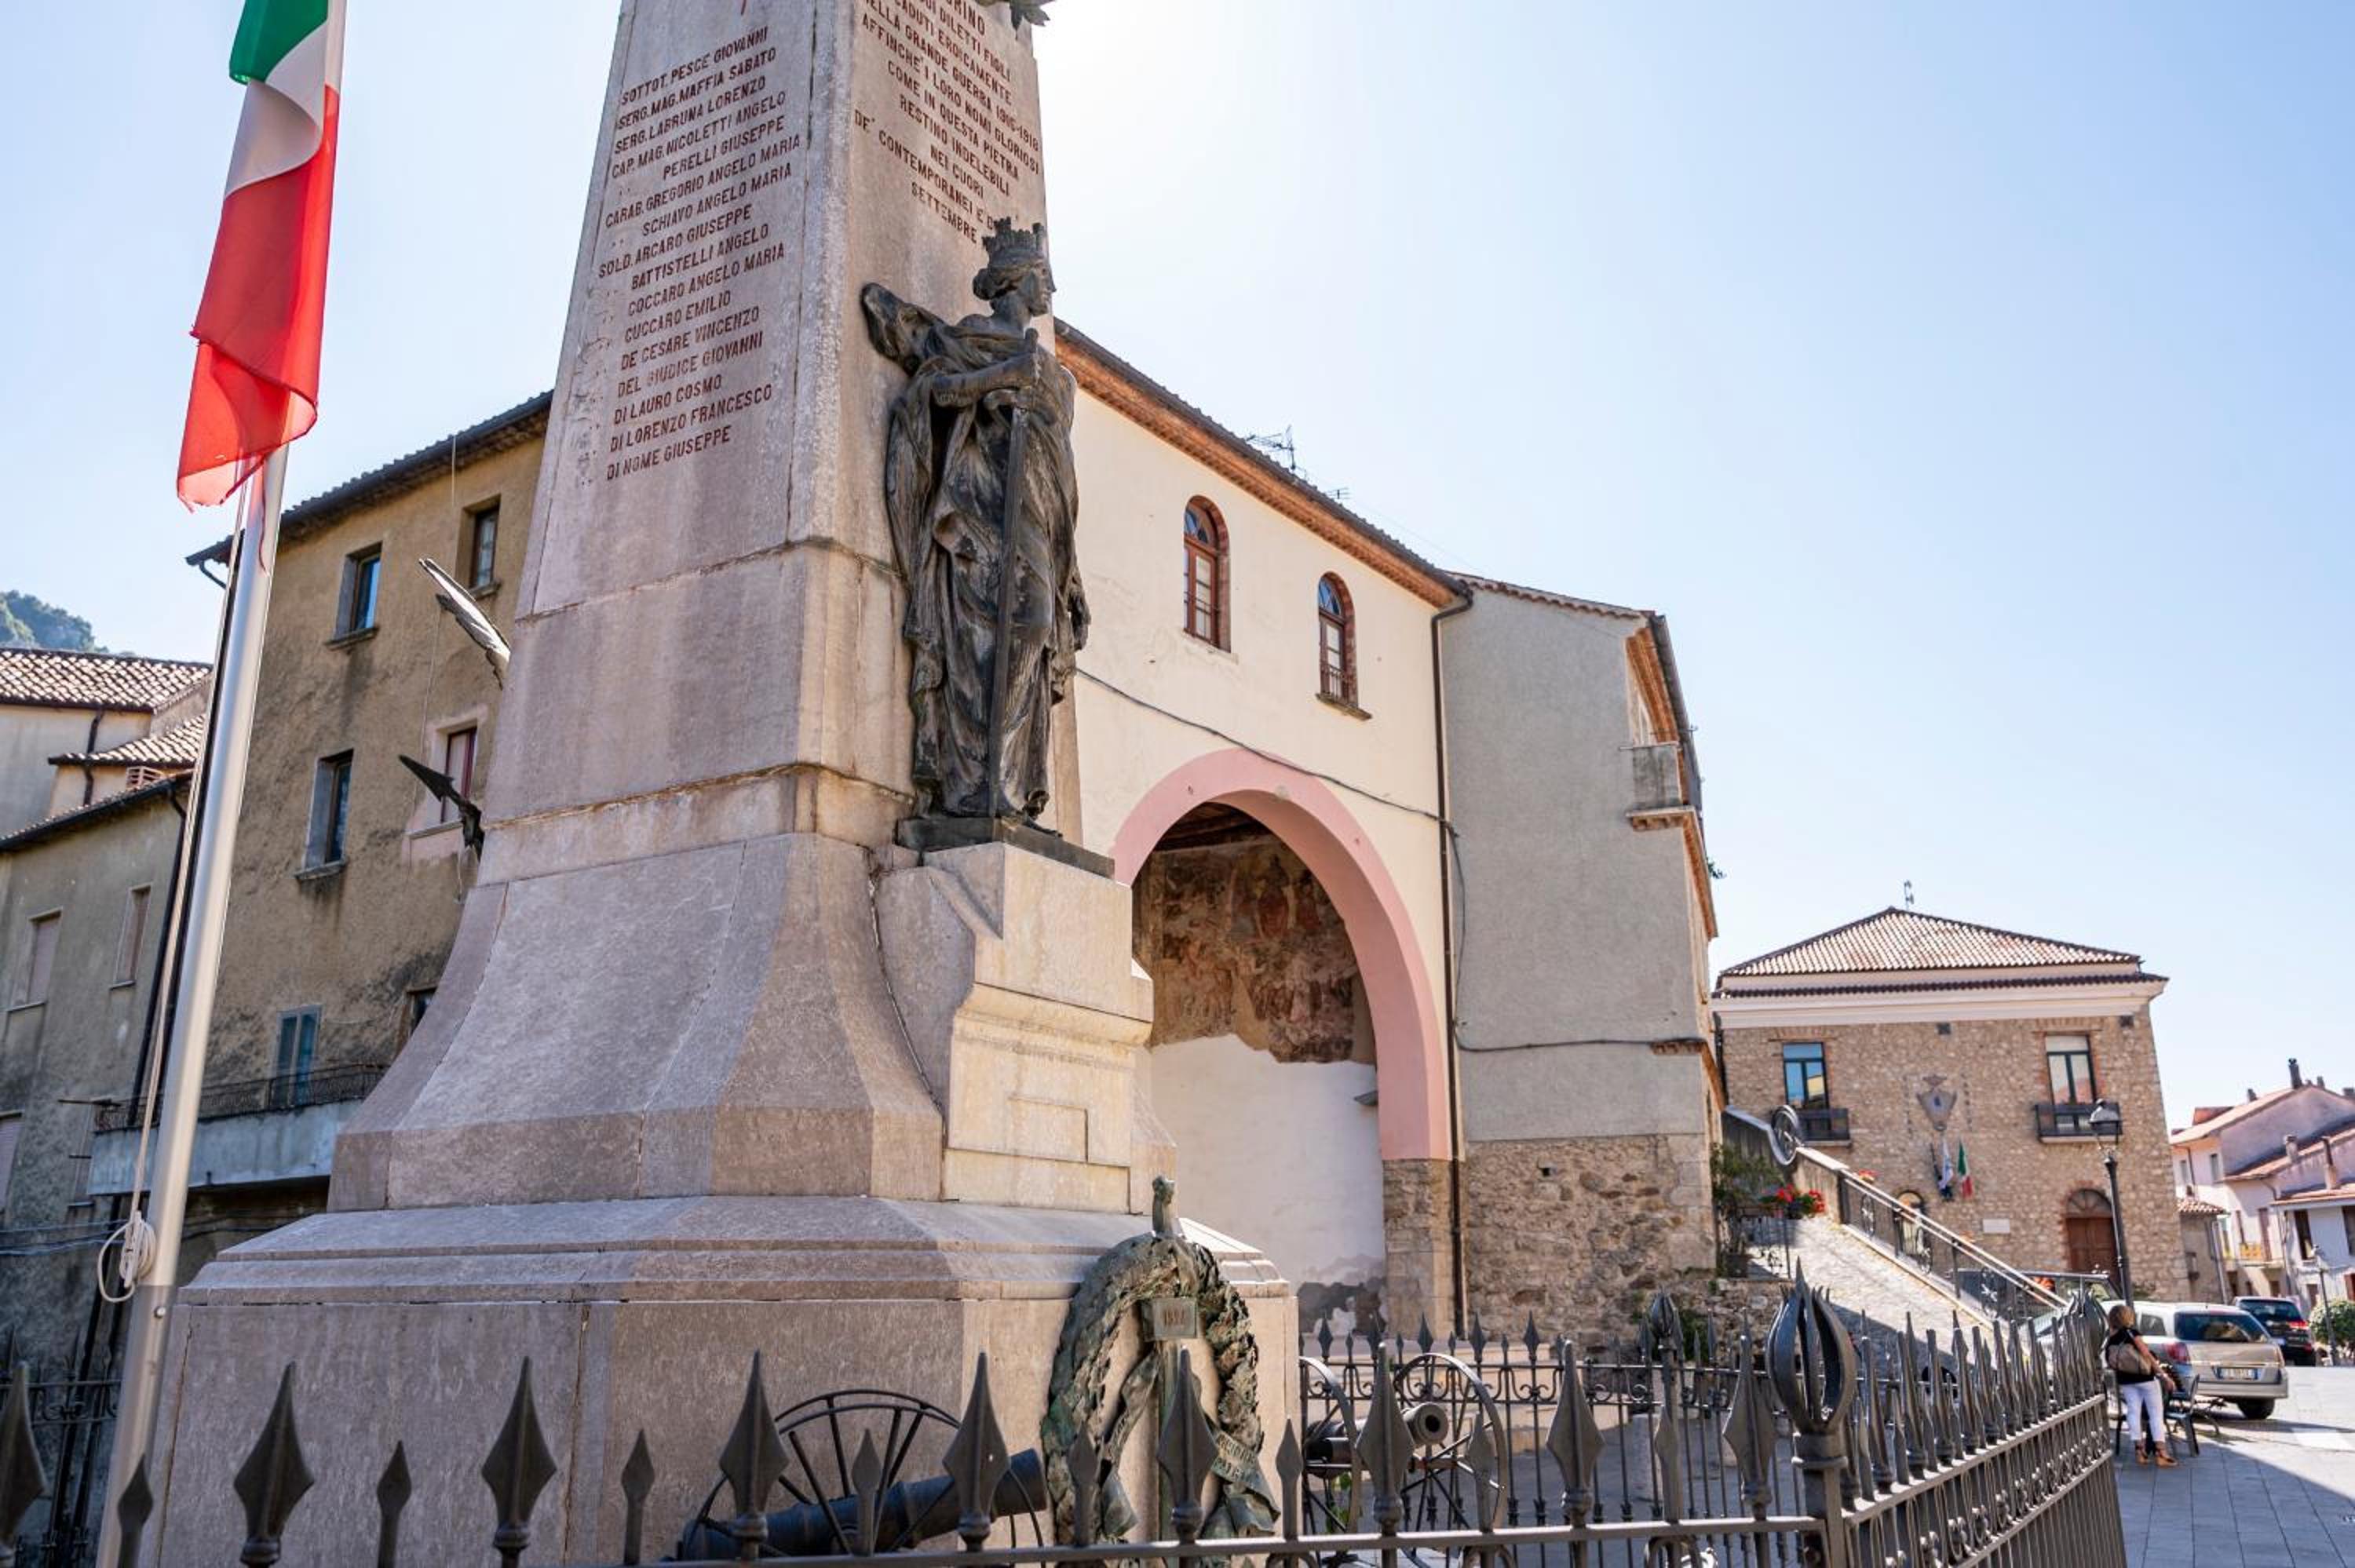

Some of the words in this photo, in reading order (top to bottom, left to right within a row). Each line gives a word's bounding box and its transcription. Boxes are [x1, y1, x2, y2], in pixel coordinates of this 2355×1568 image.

[940, 7, 981, 55] DILETTI
[947, 0, 985, 35] RINO
[618, 107, 648, 129] SERG.
[679, 71, 723, 104] MAFFIA
[729, 47, 776, 81] SABATO
[670, 53, 710, 84] PESCE
[714, 26, 768, 63] GIOVANNI
[866, 0, 900, 31] ELLA
[905, 25, 948, 72] GRANDE
[952, 67, 991, 111] GUERRA
[615, 130, 648, 155] SERG.
[708, 75, 766, 114] LORENZO
[663, 145, 717, 181] PERELLI
[721, 115, 784, 155] GIUSEPPE
[666, 115, 732, 156] NICOLETTI
[736, 91, 786, 124] ANGELO
[888, 60, 920, 98] COME
[924, 89, 935, 110] IN
[940, 104, 979, 148] QUESTA
[984, 140, 1018, 180] PIETRA
[900, 94, 947, 144] RESTINO
[952, 137, 1009, 196] INDELEBILI
[933, 73, 961, 108] LORO
[966, 100, 991, 133] NOMI
[995, 129, 1039, 175] GLORIOSI
[605, 200, 644, 228] CARAB.
[646, 175, 704, 210] GREGORIO
[707, 153, 756, 185] ANGELO
[760, 134, 800, 166] MARIA
[642, 203, 693, 236] SCHIAVO
[697, 181, 747, 215] ANGELO
[751, 162, 791, 193] MARIA
[878, 130, 973, 214] CONTEMPORANEI
[977, 207, 984, 224] E
[930, 144, 948, 170] NEI
[952, 163, 984, 199] CUORI
[598, 253, 633, 279] SOLD.
[634, 230, 682, 264] ARCARO
[687, 204, 752, 243] GIUSEPPE
[911, 181, 977, 244] SETTEMBRE
[628, 283, 685, 317] COCCARO
[688, 261, 740, 295] ANGELO
[743, 242, 784, 272] MARIA
[631, 248, 714, 290] BATTISTELLI
[717, 224, 769, 257] ANGELO
[621, 352, 637, 371] DE
[641, 331, 691, 363] CESARE
[695, 305, 760, 344] VINCENZO
[625, 308, 681, 344] CUCCARO
[685, 290, 731, 321] EMILIO
[618, 376, 641, 398] DEL
[648, 355, 697, 388] GIUDICE
[703, 330, 764, 366] GIOVANNI
[610, 435, 623, 453] DI
[626, 414, 686, 447] LORENZO
[690, 384, 772, 425] FRANCESCO
[614, 407, 626, 425] DI
[630, 392, 671, 419] LAURO
[676, 374, 722, 404] COSMO
[607, 462, 619, 480] DI
[623, 449, 660, 476] NOME
[663, 425, 731, 461] GIUSEPPE
